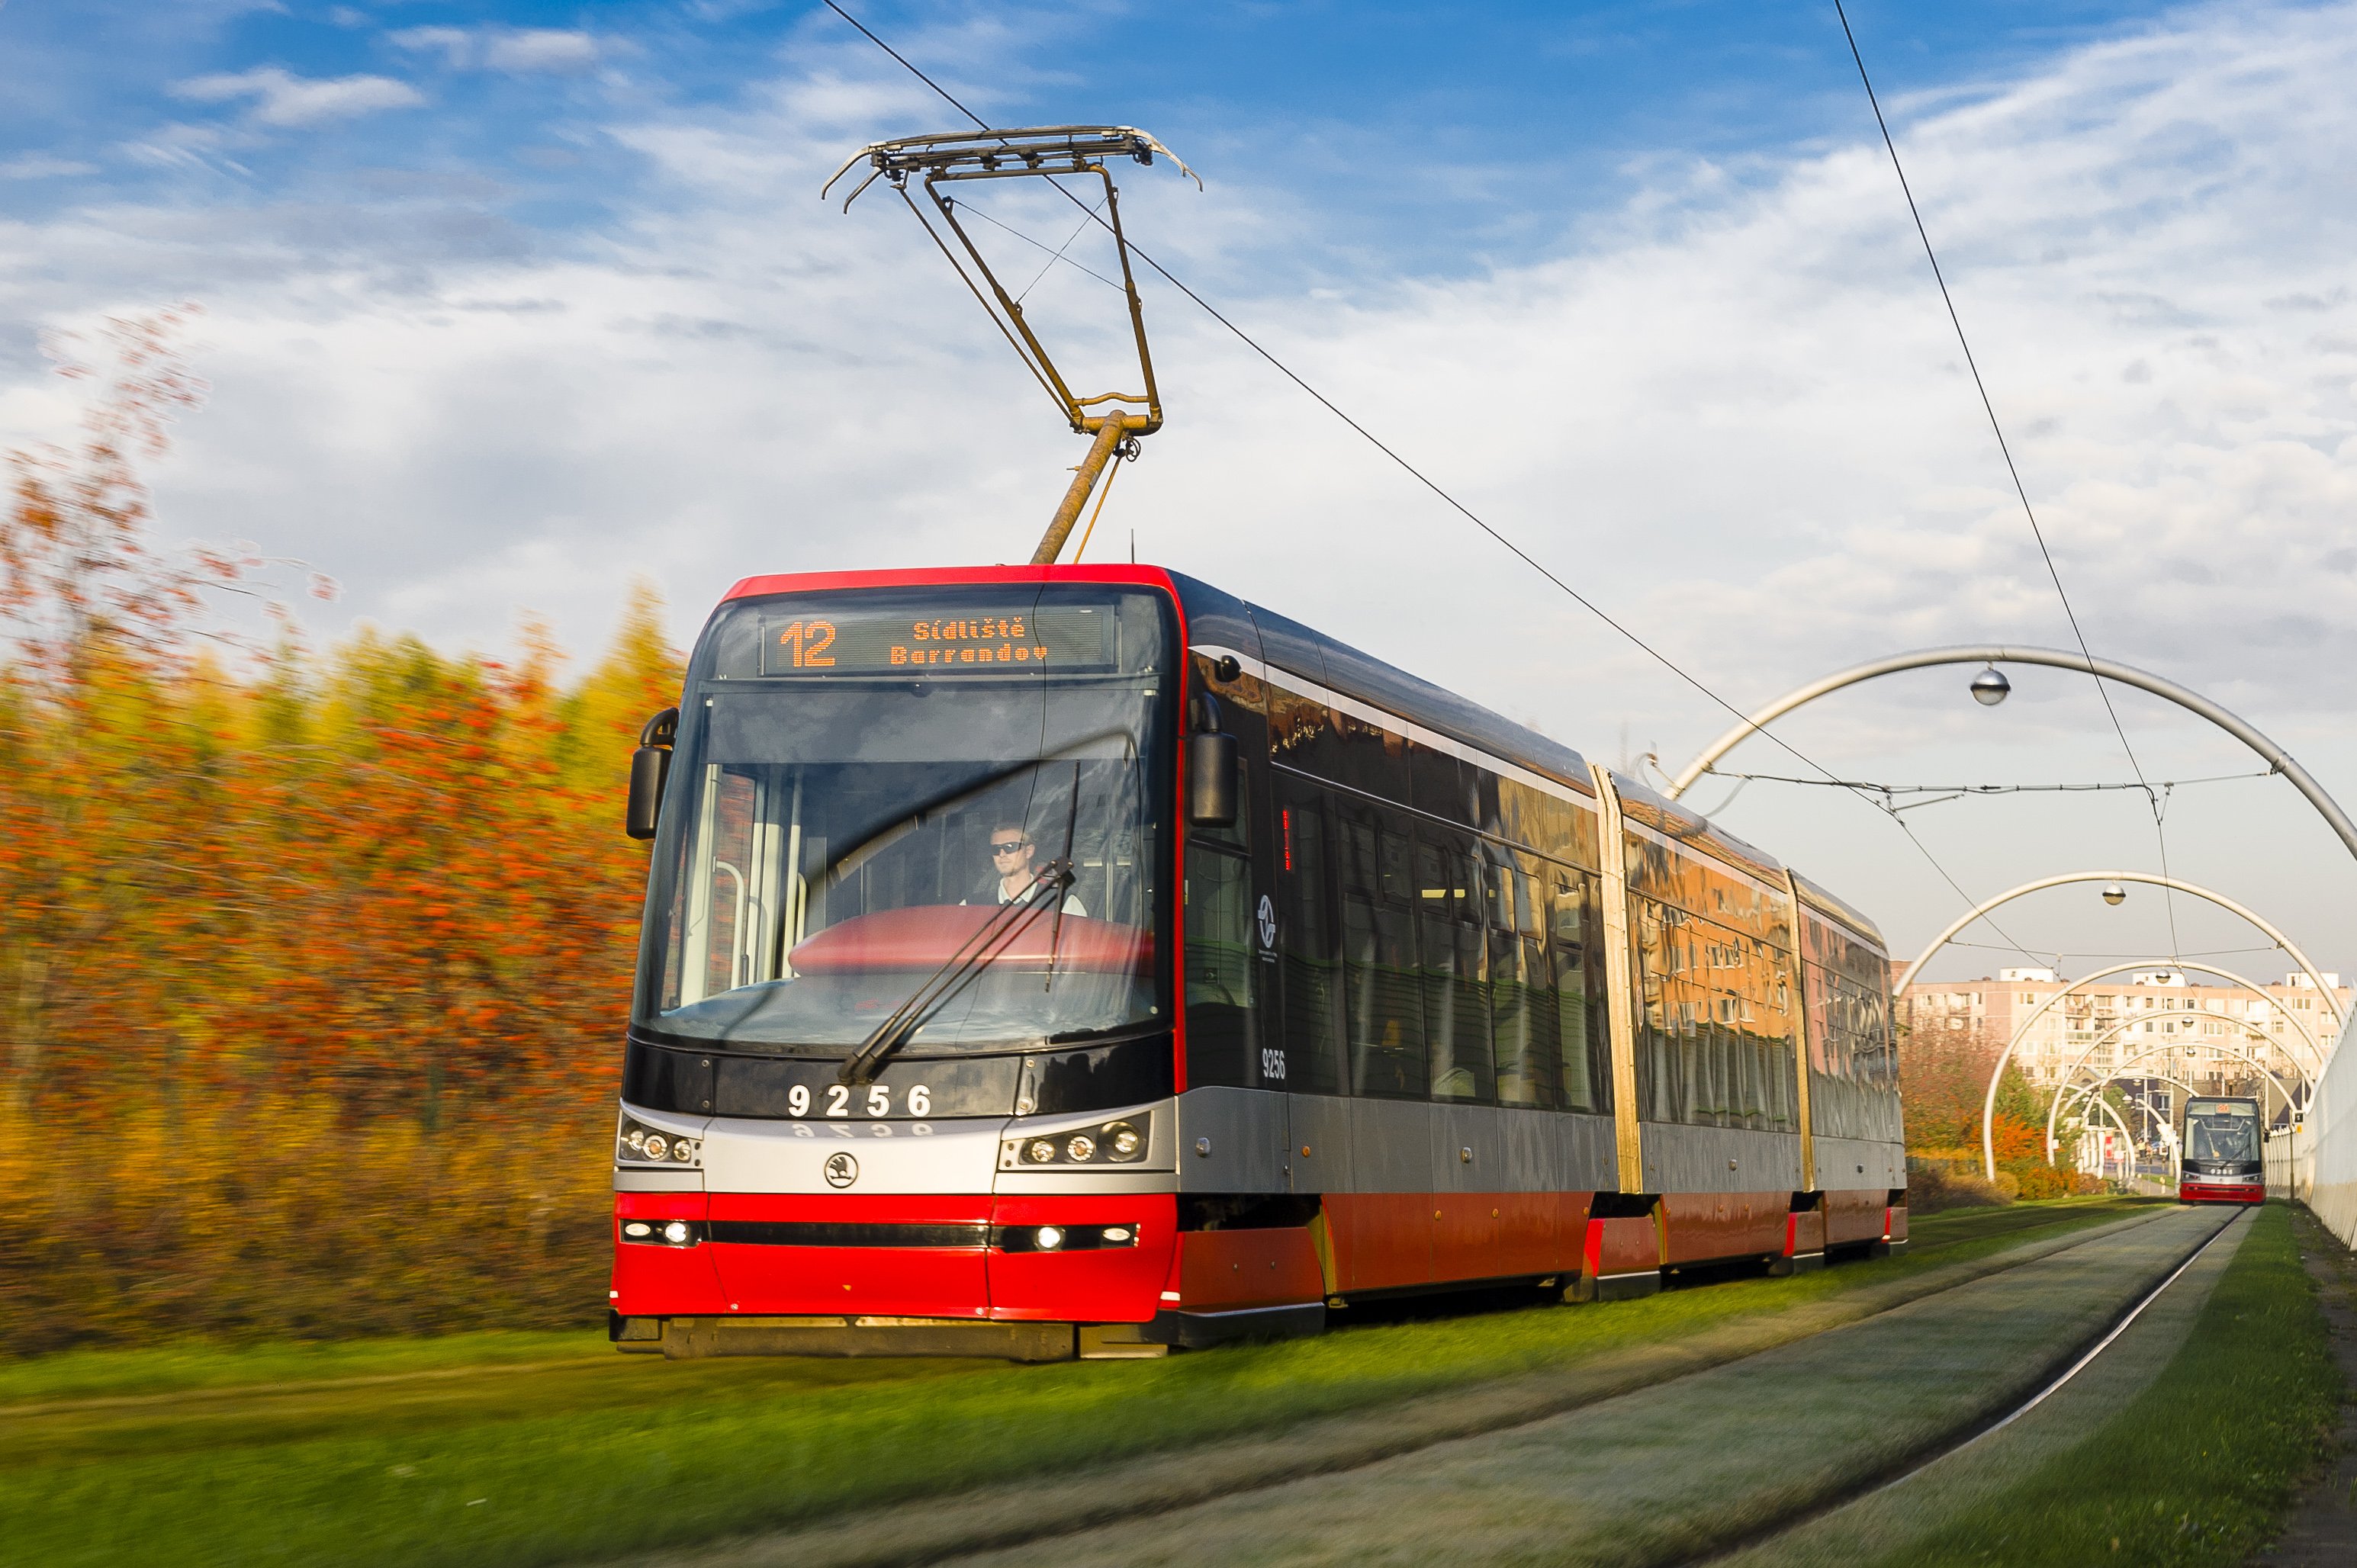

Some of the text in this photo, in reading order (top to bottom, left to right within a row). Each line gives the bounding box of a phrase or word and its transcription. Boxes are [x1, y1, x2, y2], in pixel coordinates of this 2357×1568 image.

[780, 621, 836, 667] 12
[914, 617, 1026, 641] Sídliště
[890, 643, 1048, 665] Barrandov
[1262, 1048, 1285, 1080] 9256
[788, 1084, 931, 1117] 9256
